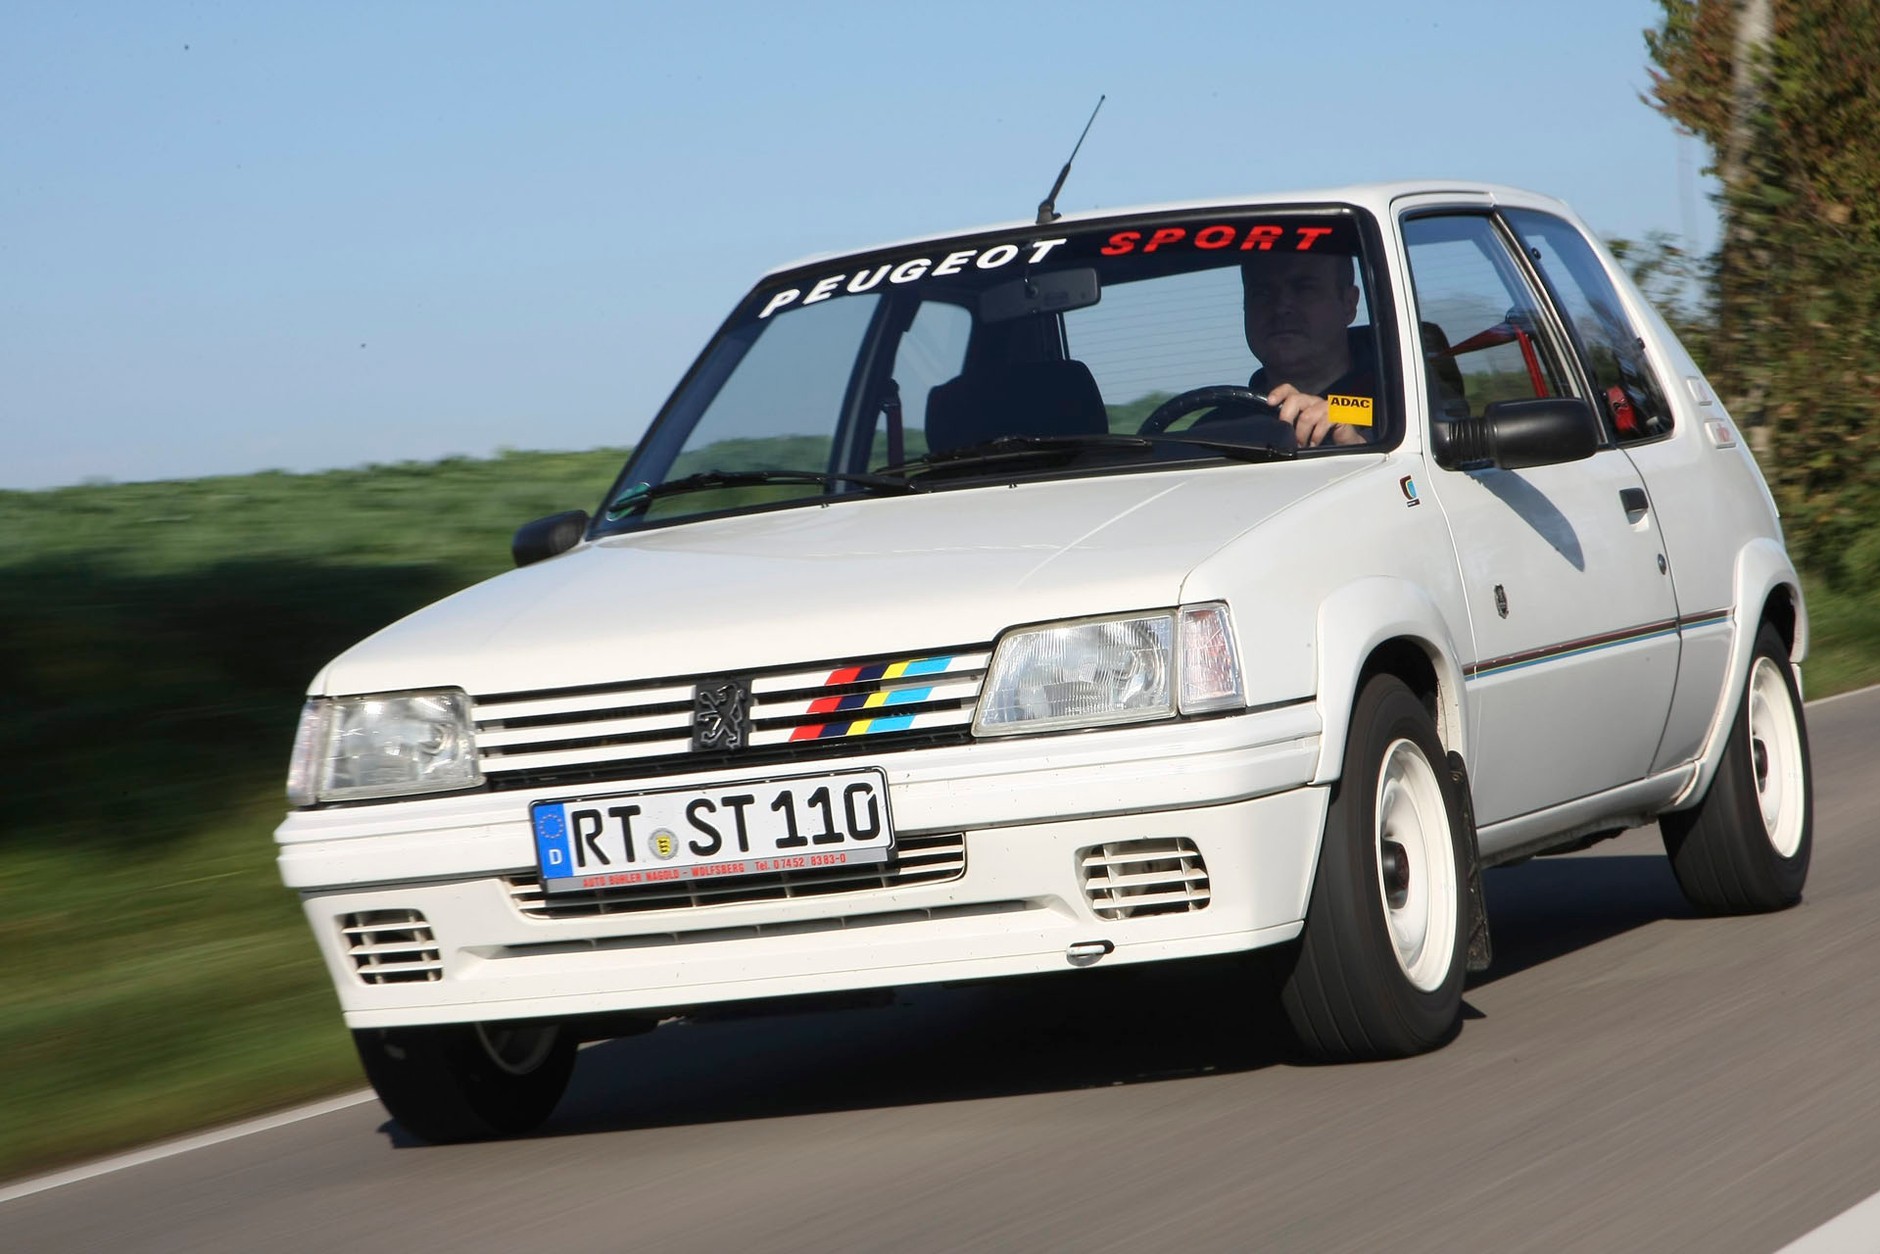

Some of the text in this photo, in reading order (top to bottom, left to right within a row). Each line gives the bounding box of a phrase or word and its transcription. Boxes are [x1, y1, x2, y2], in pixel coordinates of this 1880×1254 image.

[758, 224, 1333, 319] PEUGEOT SPORT
[1330, 396, 1370, 408] ADAC
[571, 782, 881, 868] RT ST 110
[549, 848, 563, 865] D
[582, 875, 607, 888] AUTO
[690, 862, 745, 878] WOLFSBERG
